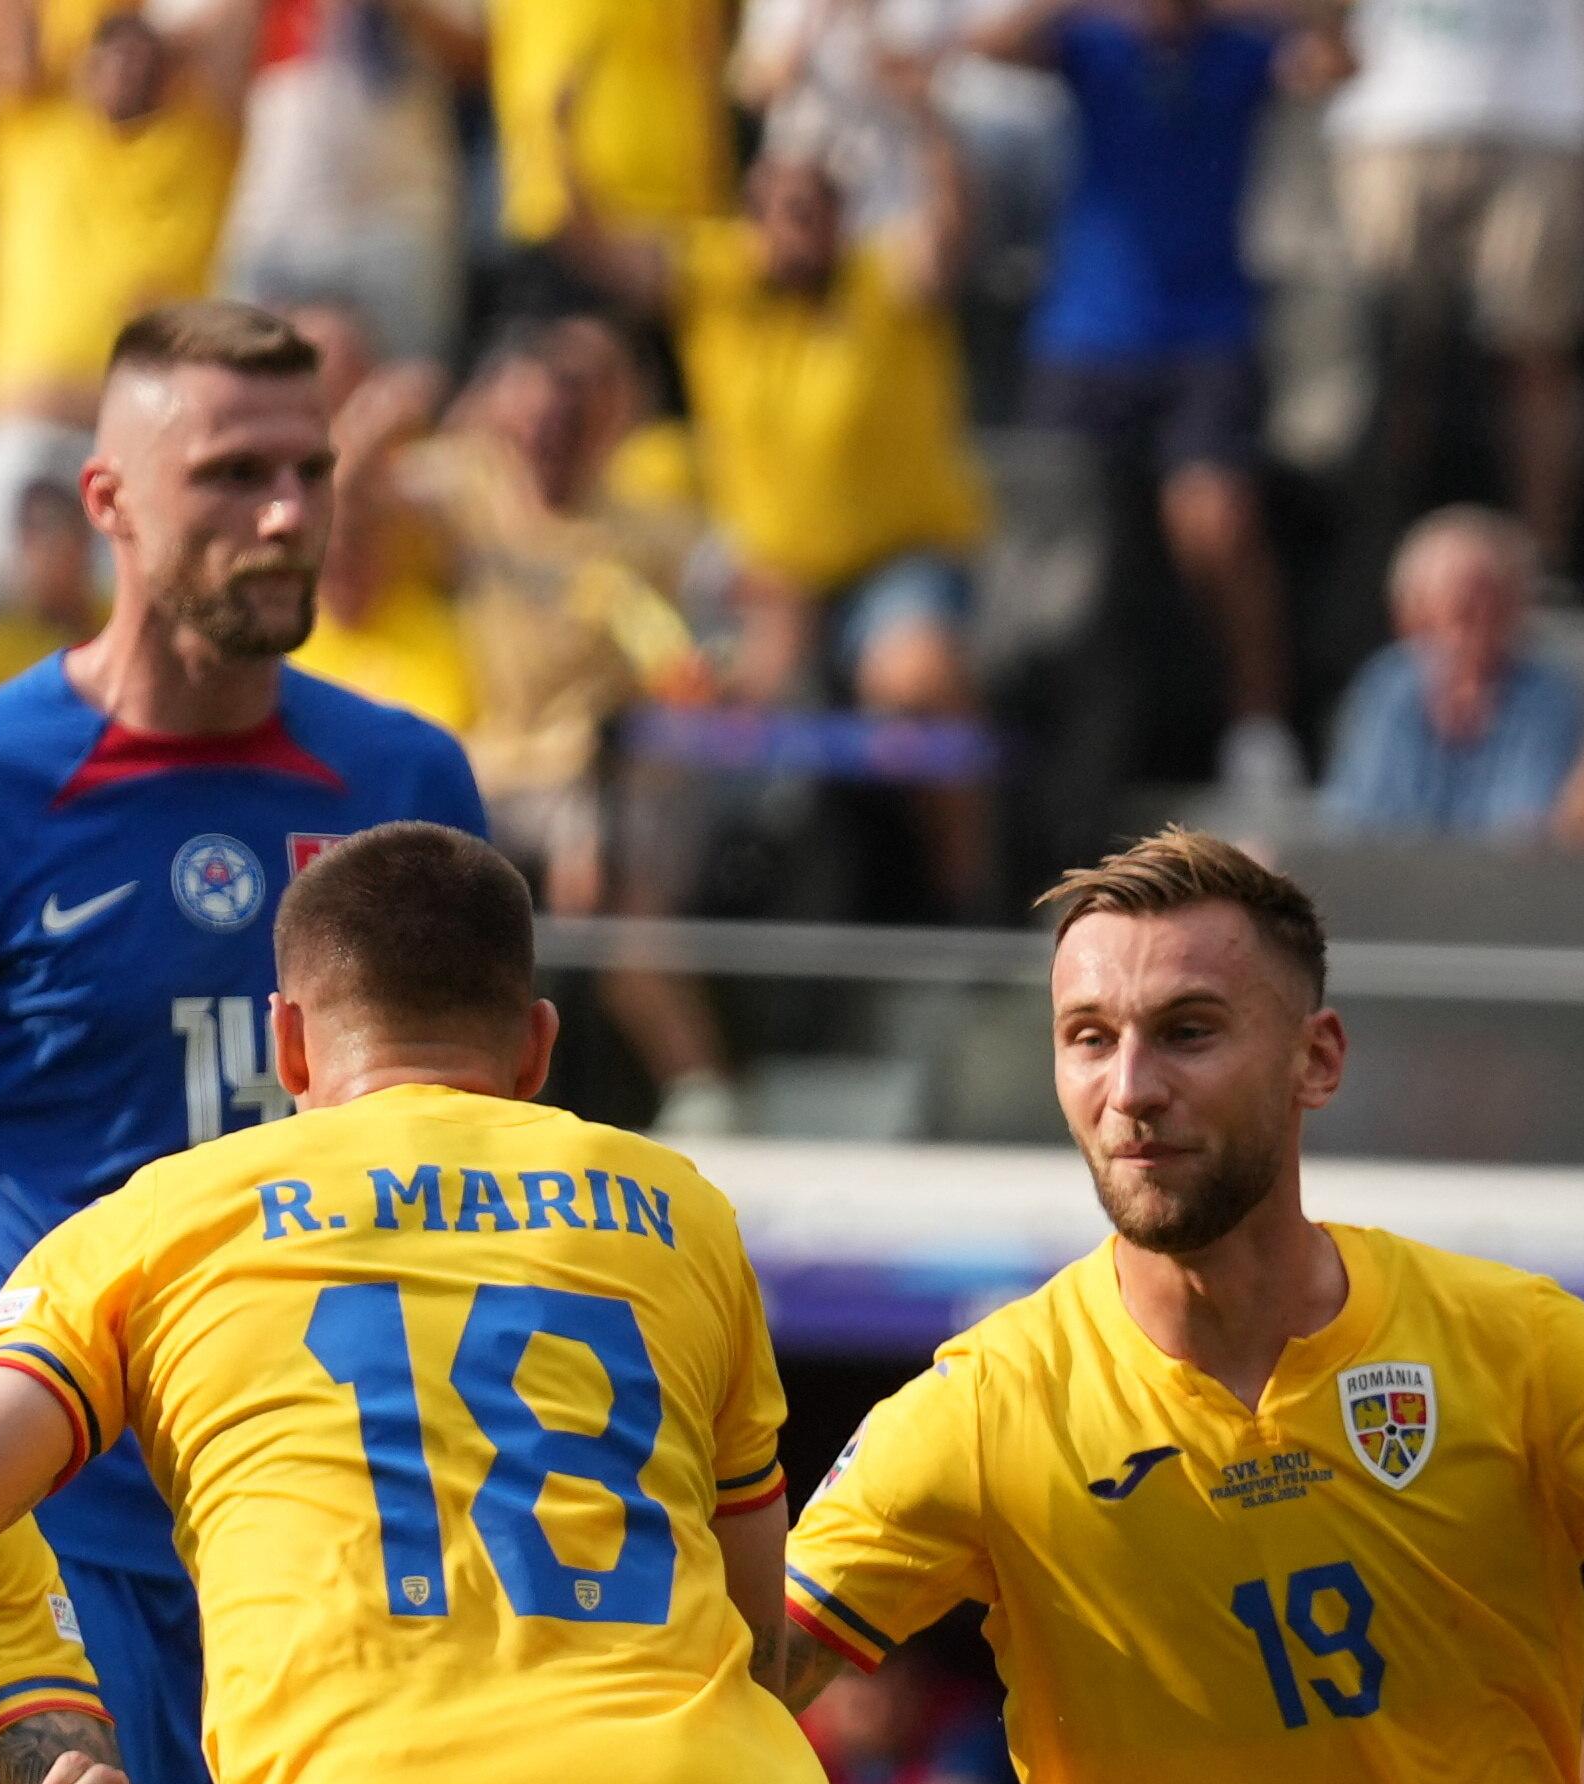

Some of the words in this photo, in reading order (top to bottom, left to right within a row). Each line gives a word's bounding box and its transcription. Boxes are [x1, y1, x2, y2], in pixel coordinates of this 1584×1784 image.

[171, 996, 296, 1146] 14
[257, 1179, 346, 1241] R.
[367, 1164, 675, 1249] MARIN
[1347, 1365, 1424, 1395] ROMÂNIA
[303, 1281, 677, 1625] 18
[1221, 1459, 1258, 1483] SVK
[1271, 1450, 1310, 1472] ROU
[1230, 1561, 1386, 1729] 19
